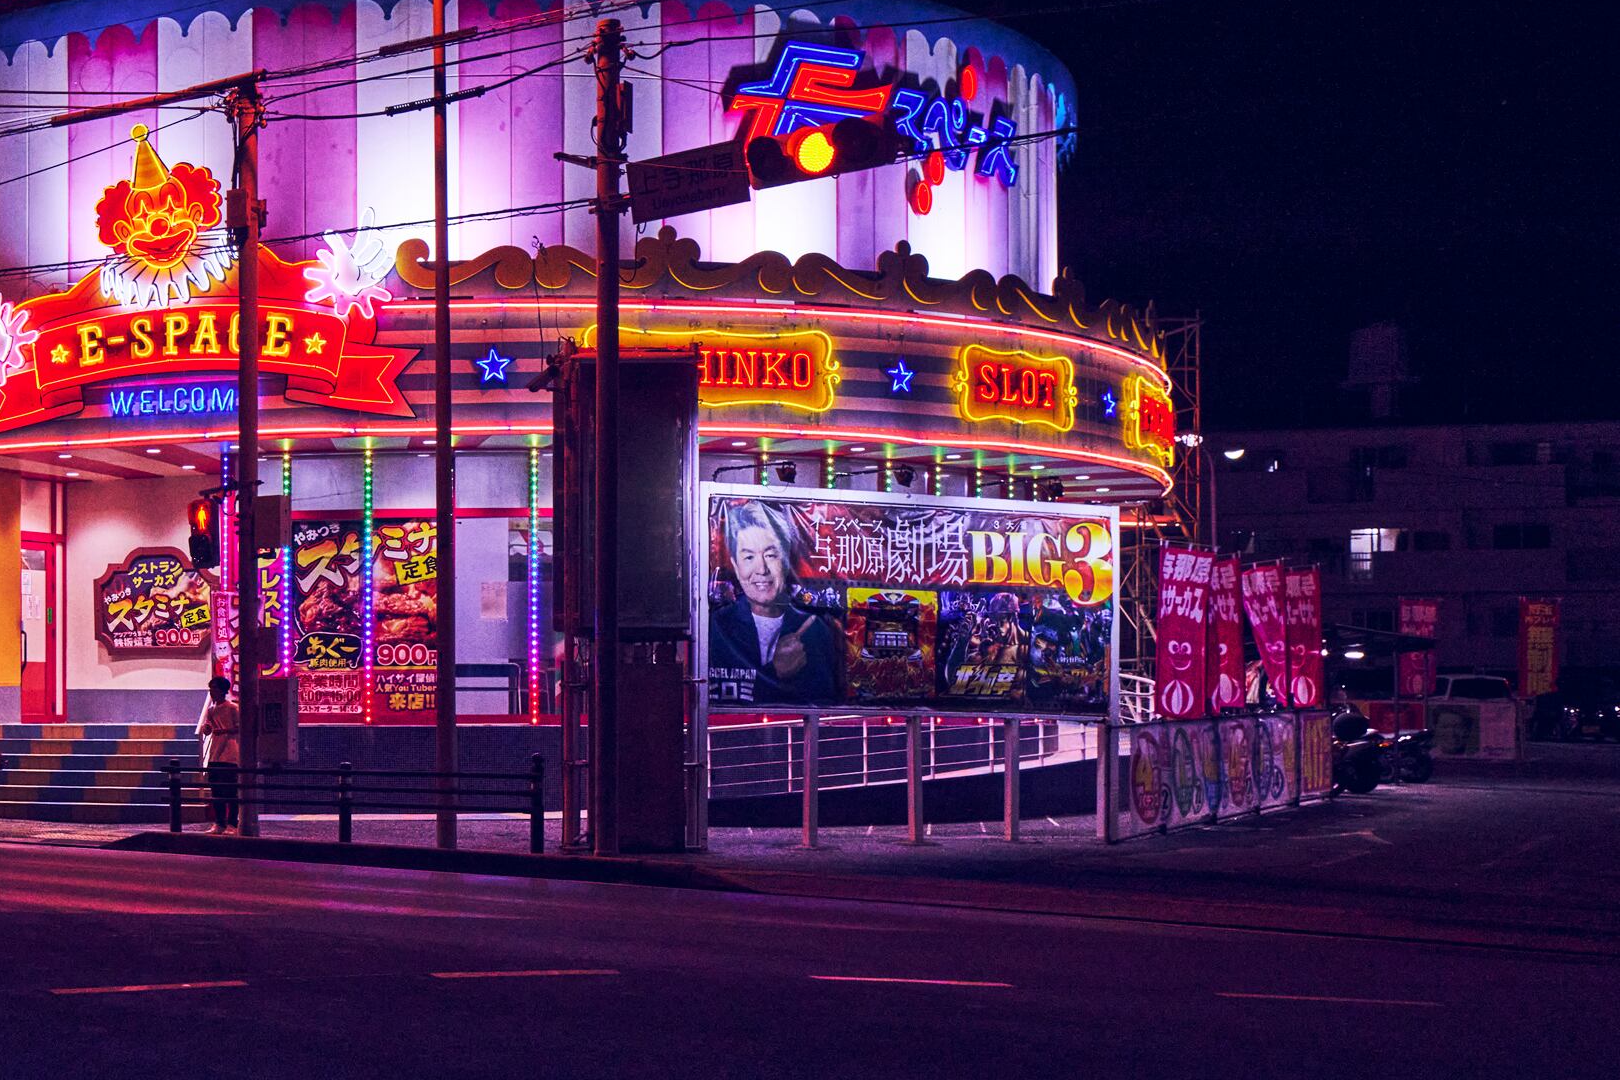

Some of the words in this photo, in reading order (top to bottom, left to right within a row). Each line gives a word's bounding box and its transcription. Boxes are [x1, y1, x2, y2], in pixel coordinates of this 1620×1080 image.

[698, 350, 811, 387] HINKO
[977, 362, 1057, 408] SLOT
[110, 387, 235, 415] WELCOM
[294, 524, 340, 545] やみつき
[810, 516, 884, 532] イースペース
[296, 522, 437, 593] スタミナ
[810, 514, 968, 586] 与那原劇場
[967, 522, 1114, 605] BIG3
[1163, 552, 1213, 584] 与那原
[401, 557, 437, 581] 定食
[133, 574, 175, 588] サーカス
[104, 588, 132, 604] やみつき
[107, 594, 190, 632] スタミナ
[184, 608, 208, 625] 定食
[216, 598, 229, 639] お食事処
[155, 628, 201, 646] 900円
[307, 637, 359, 659] あぐー
[377, 644, 437, 666] 900円
[299, 673, 359, 689] 営業時間
[376, 674, 437, 683] ハイサイ探偵
[730, 668, 757, 679] JAPAN
